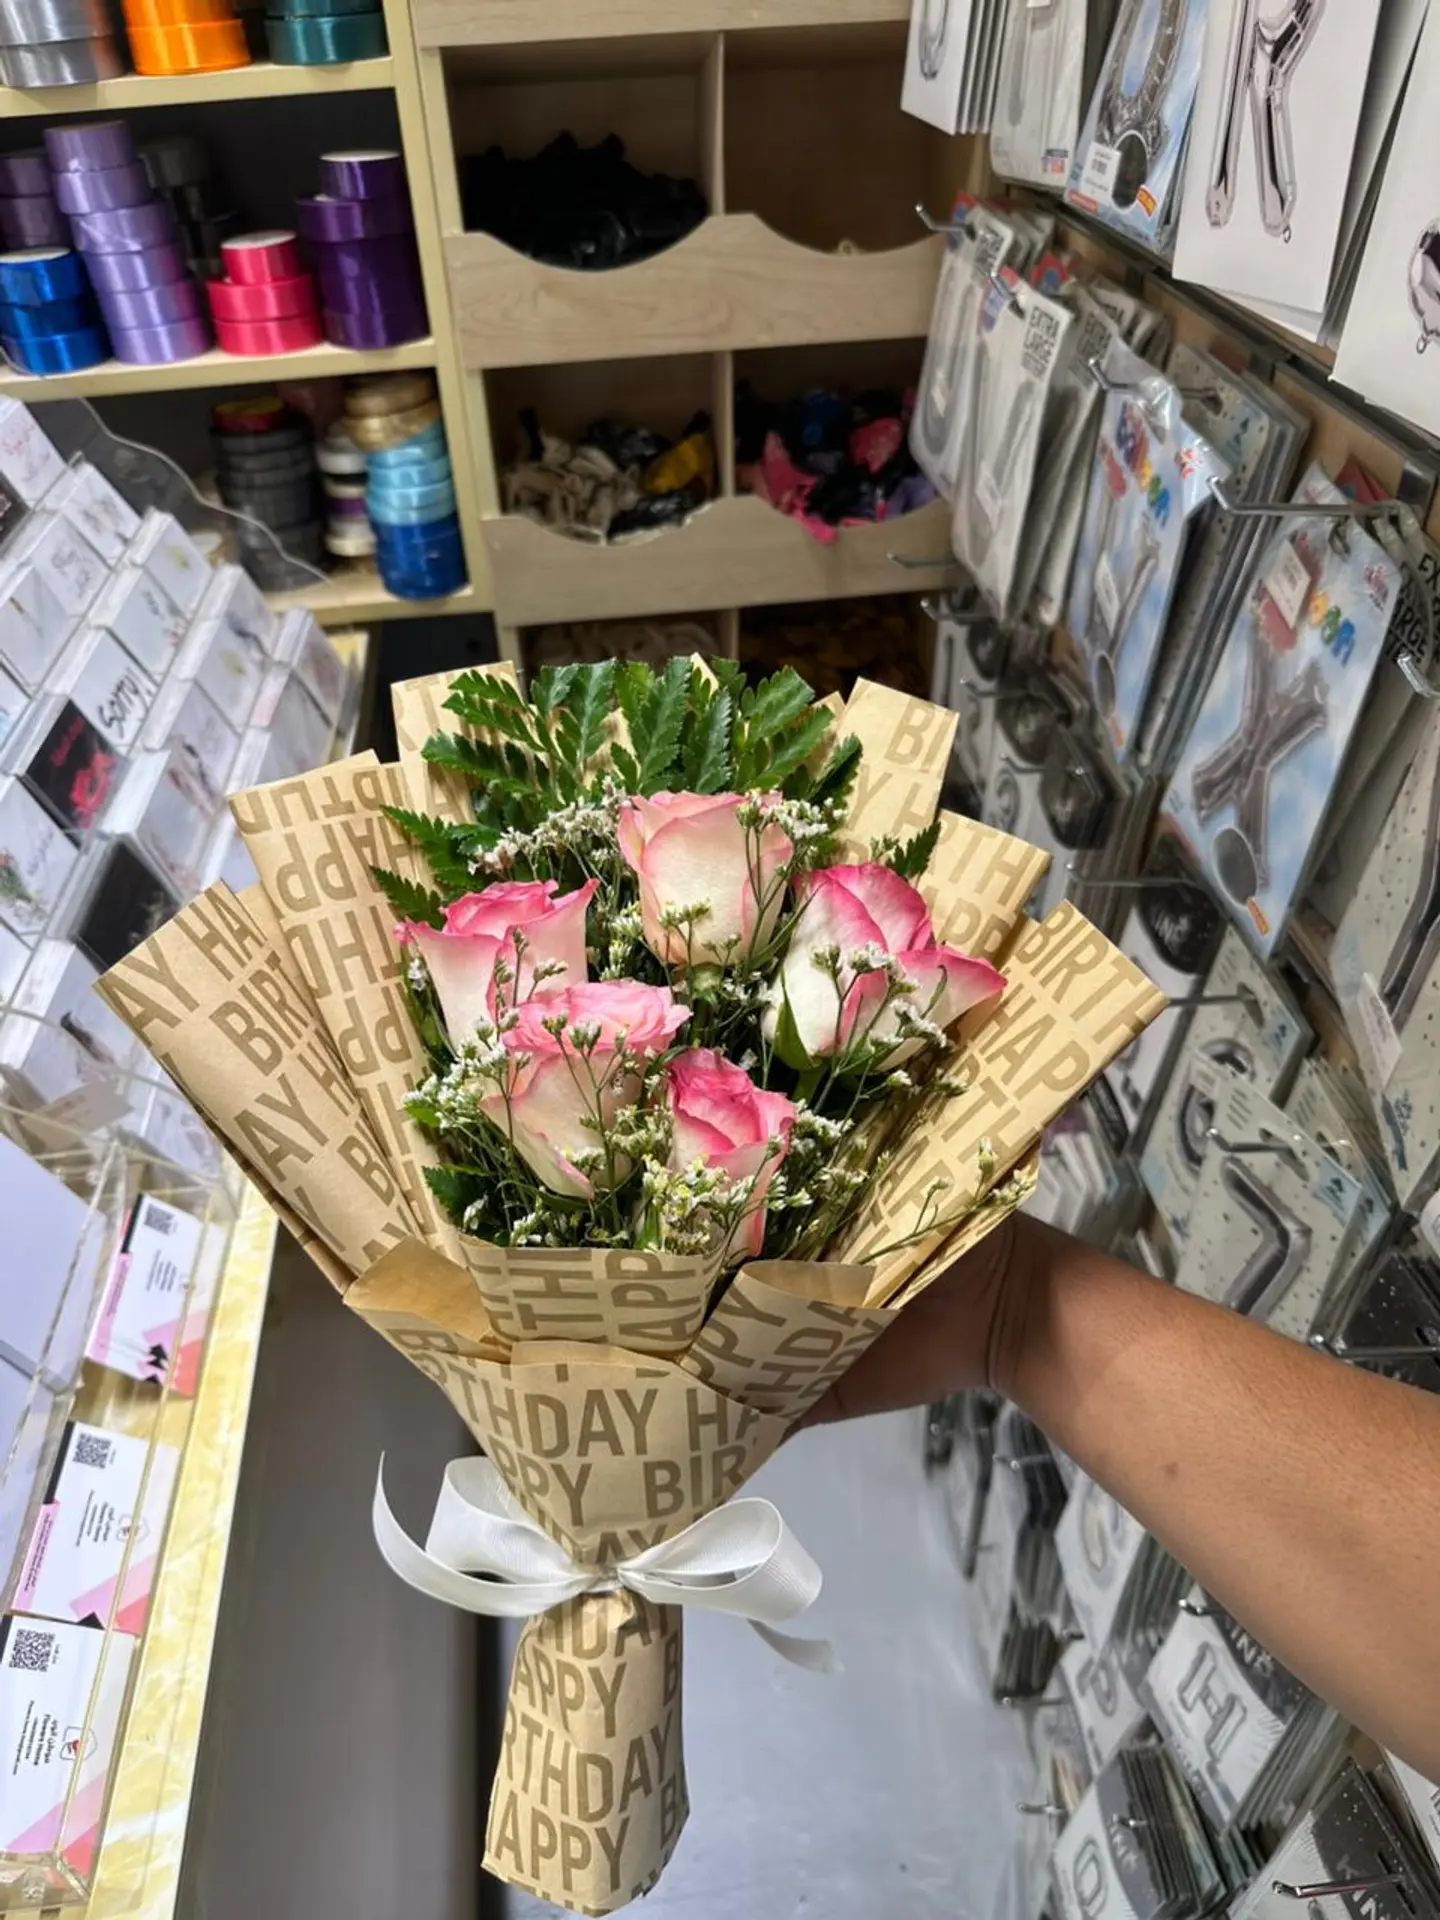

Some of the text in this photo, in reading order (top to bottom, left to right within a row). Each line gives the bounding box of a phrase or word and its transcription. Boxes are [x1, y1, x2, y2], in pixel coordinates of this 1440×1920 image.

[99, 937, 200, 1048] AY
[336, 984, 413, 1077] PP
[505, 1248, 604, 1330] TH
